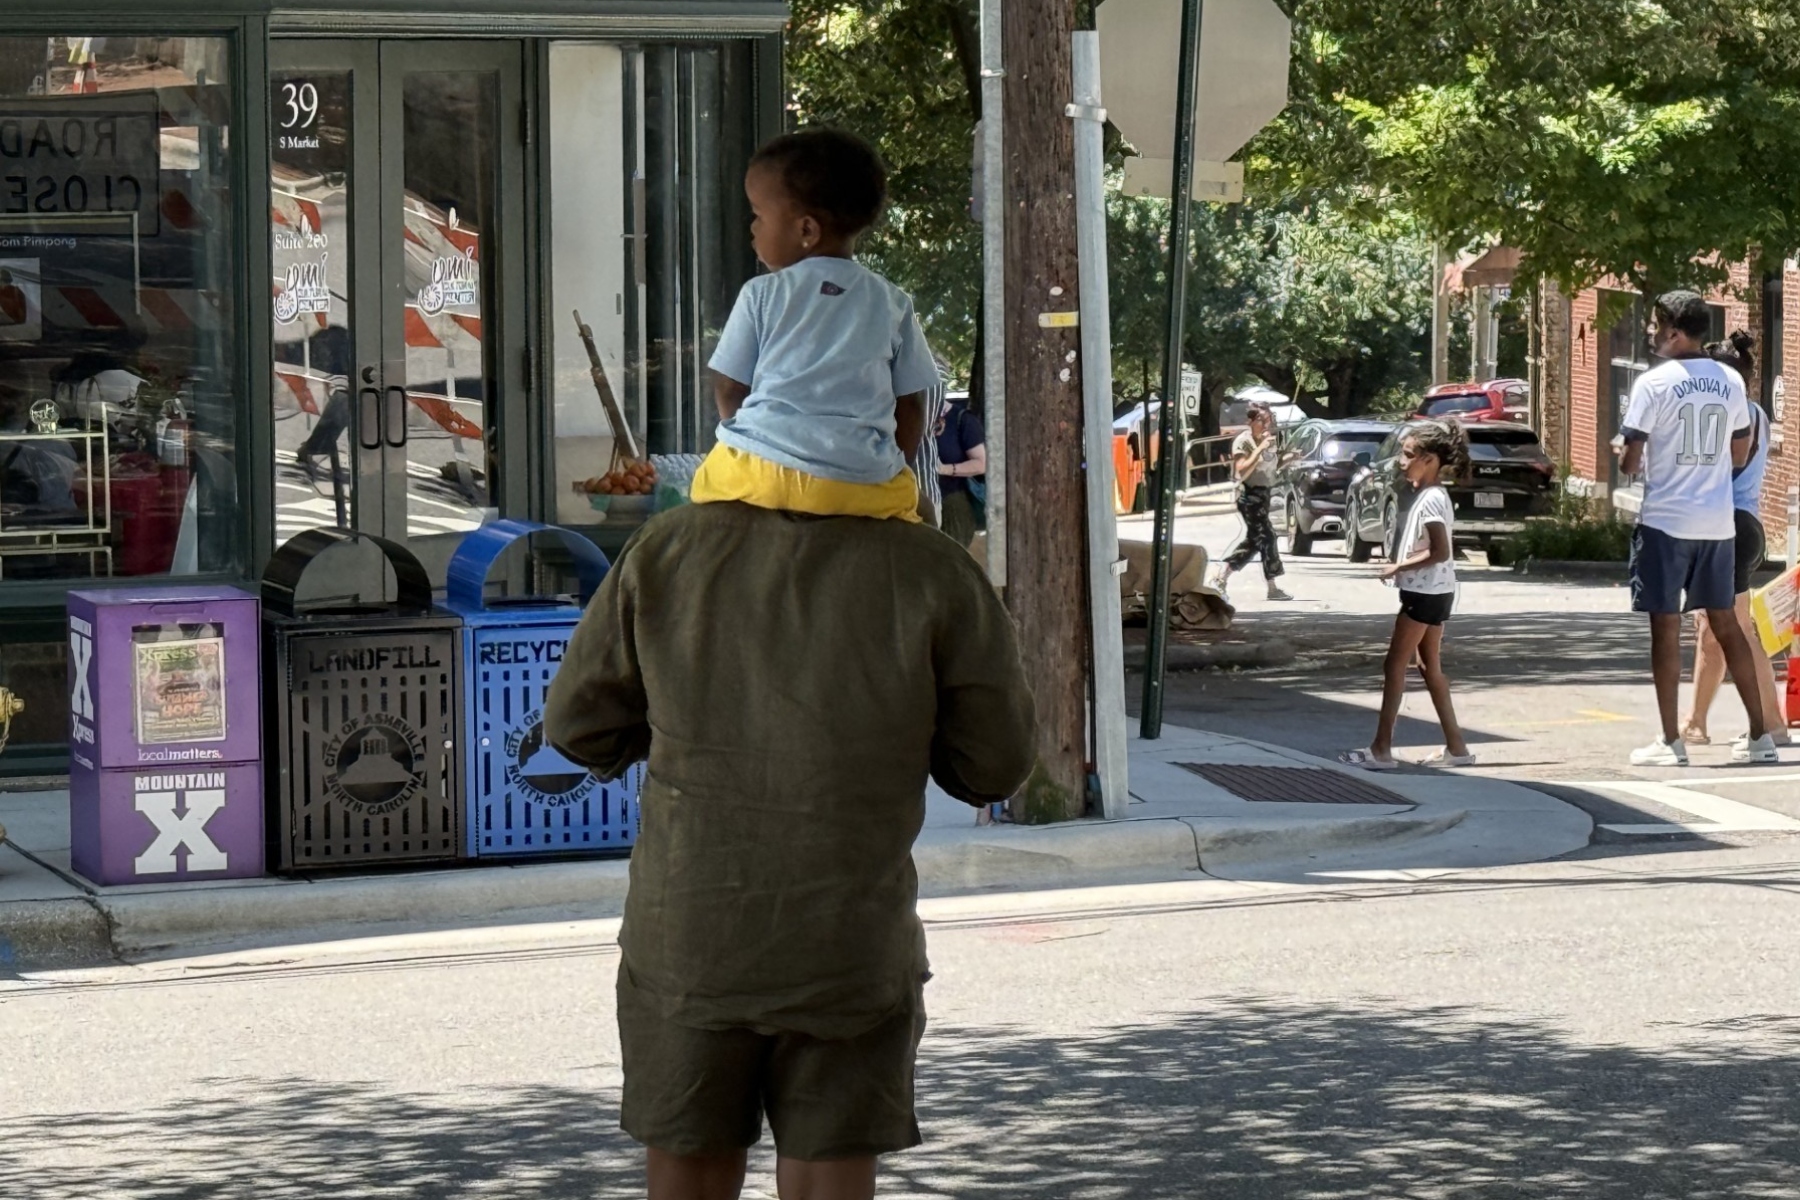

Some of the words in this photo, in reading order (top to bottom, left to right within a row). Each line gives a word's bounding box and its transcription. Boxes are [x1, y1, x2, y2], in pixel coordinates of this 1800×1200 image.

[280, 83, 318, 128] 39
[280, 136, 286, 149] S
[287, 135, 319, 149] Market
[0, 238, 20, 247] om
[1673, 377, 1732, 401] DONOVAN
[1676, 402, 1728, 466] 10
[308, 645, 441, 673] LANDFILL
[134, 772, 226, 791] MOUNTAIN
